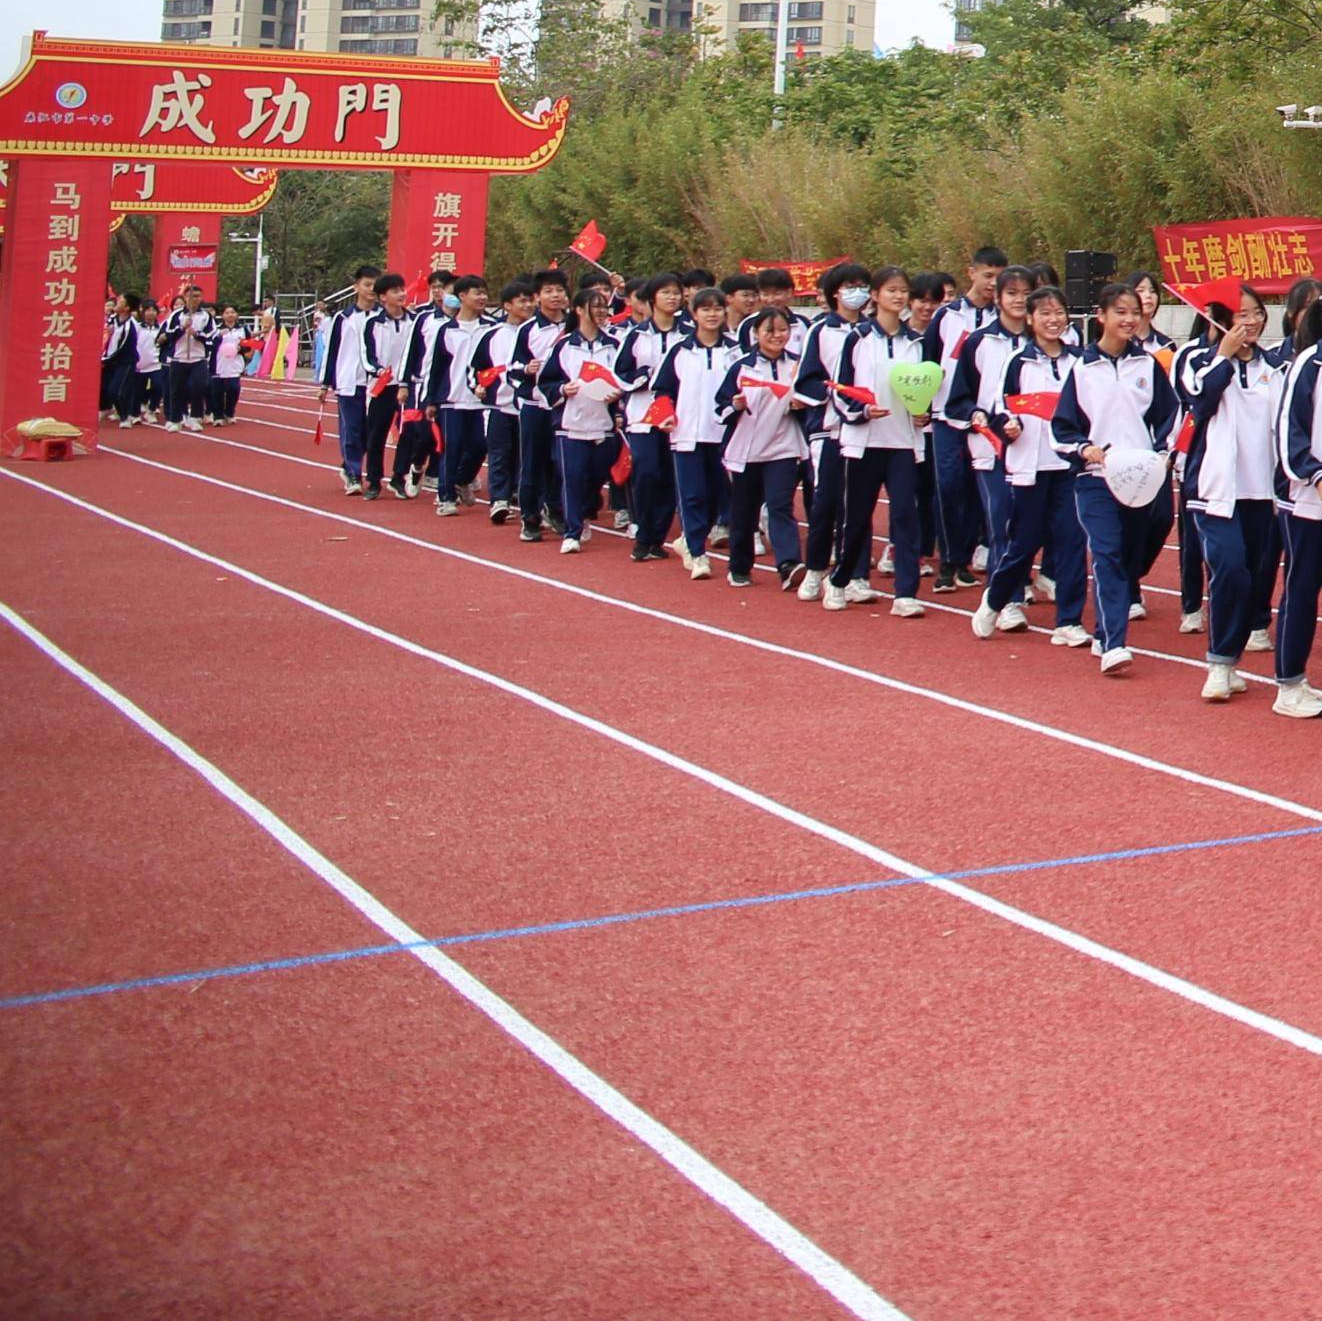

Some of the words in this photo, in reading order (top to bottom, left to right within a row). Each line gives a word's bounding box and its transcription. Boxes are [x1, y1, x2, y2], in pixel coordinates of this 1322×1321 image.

[138, 69, 403, 151] 成功門
[38, 182, 82, 403] 马到成功龙抬首
[1164, 229, 1314, 283] 十年磨剑酬壮志
